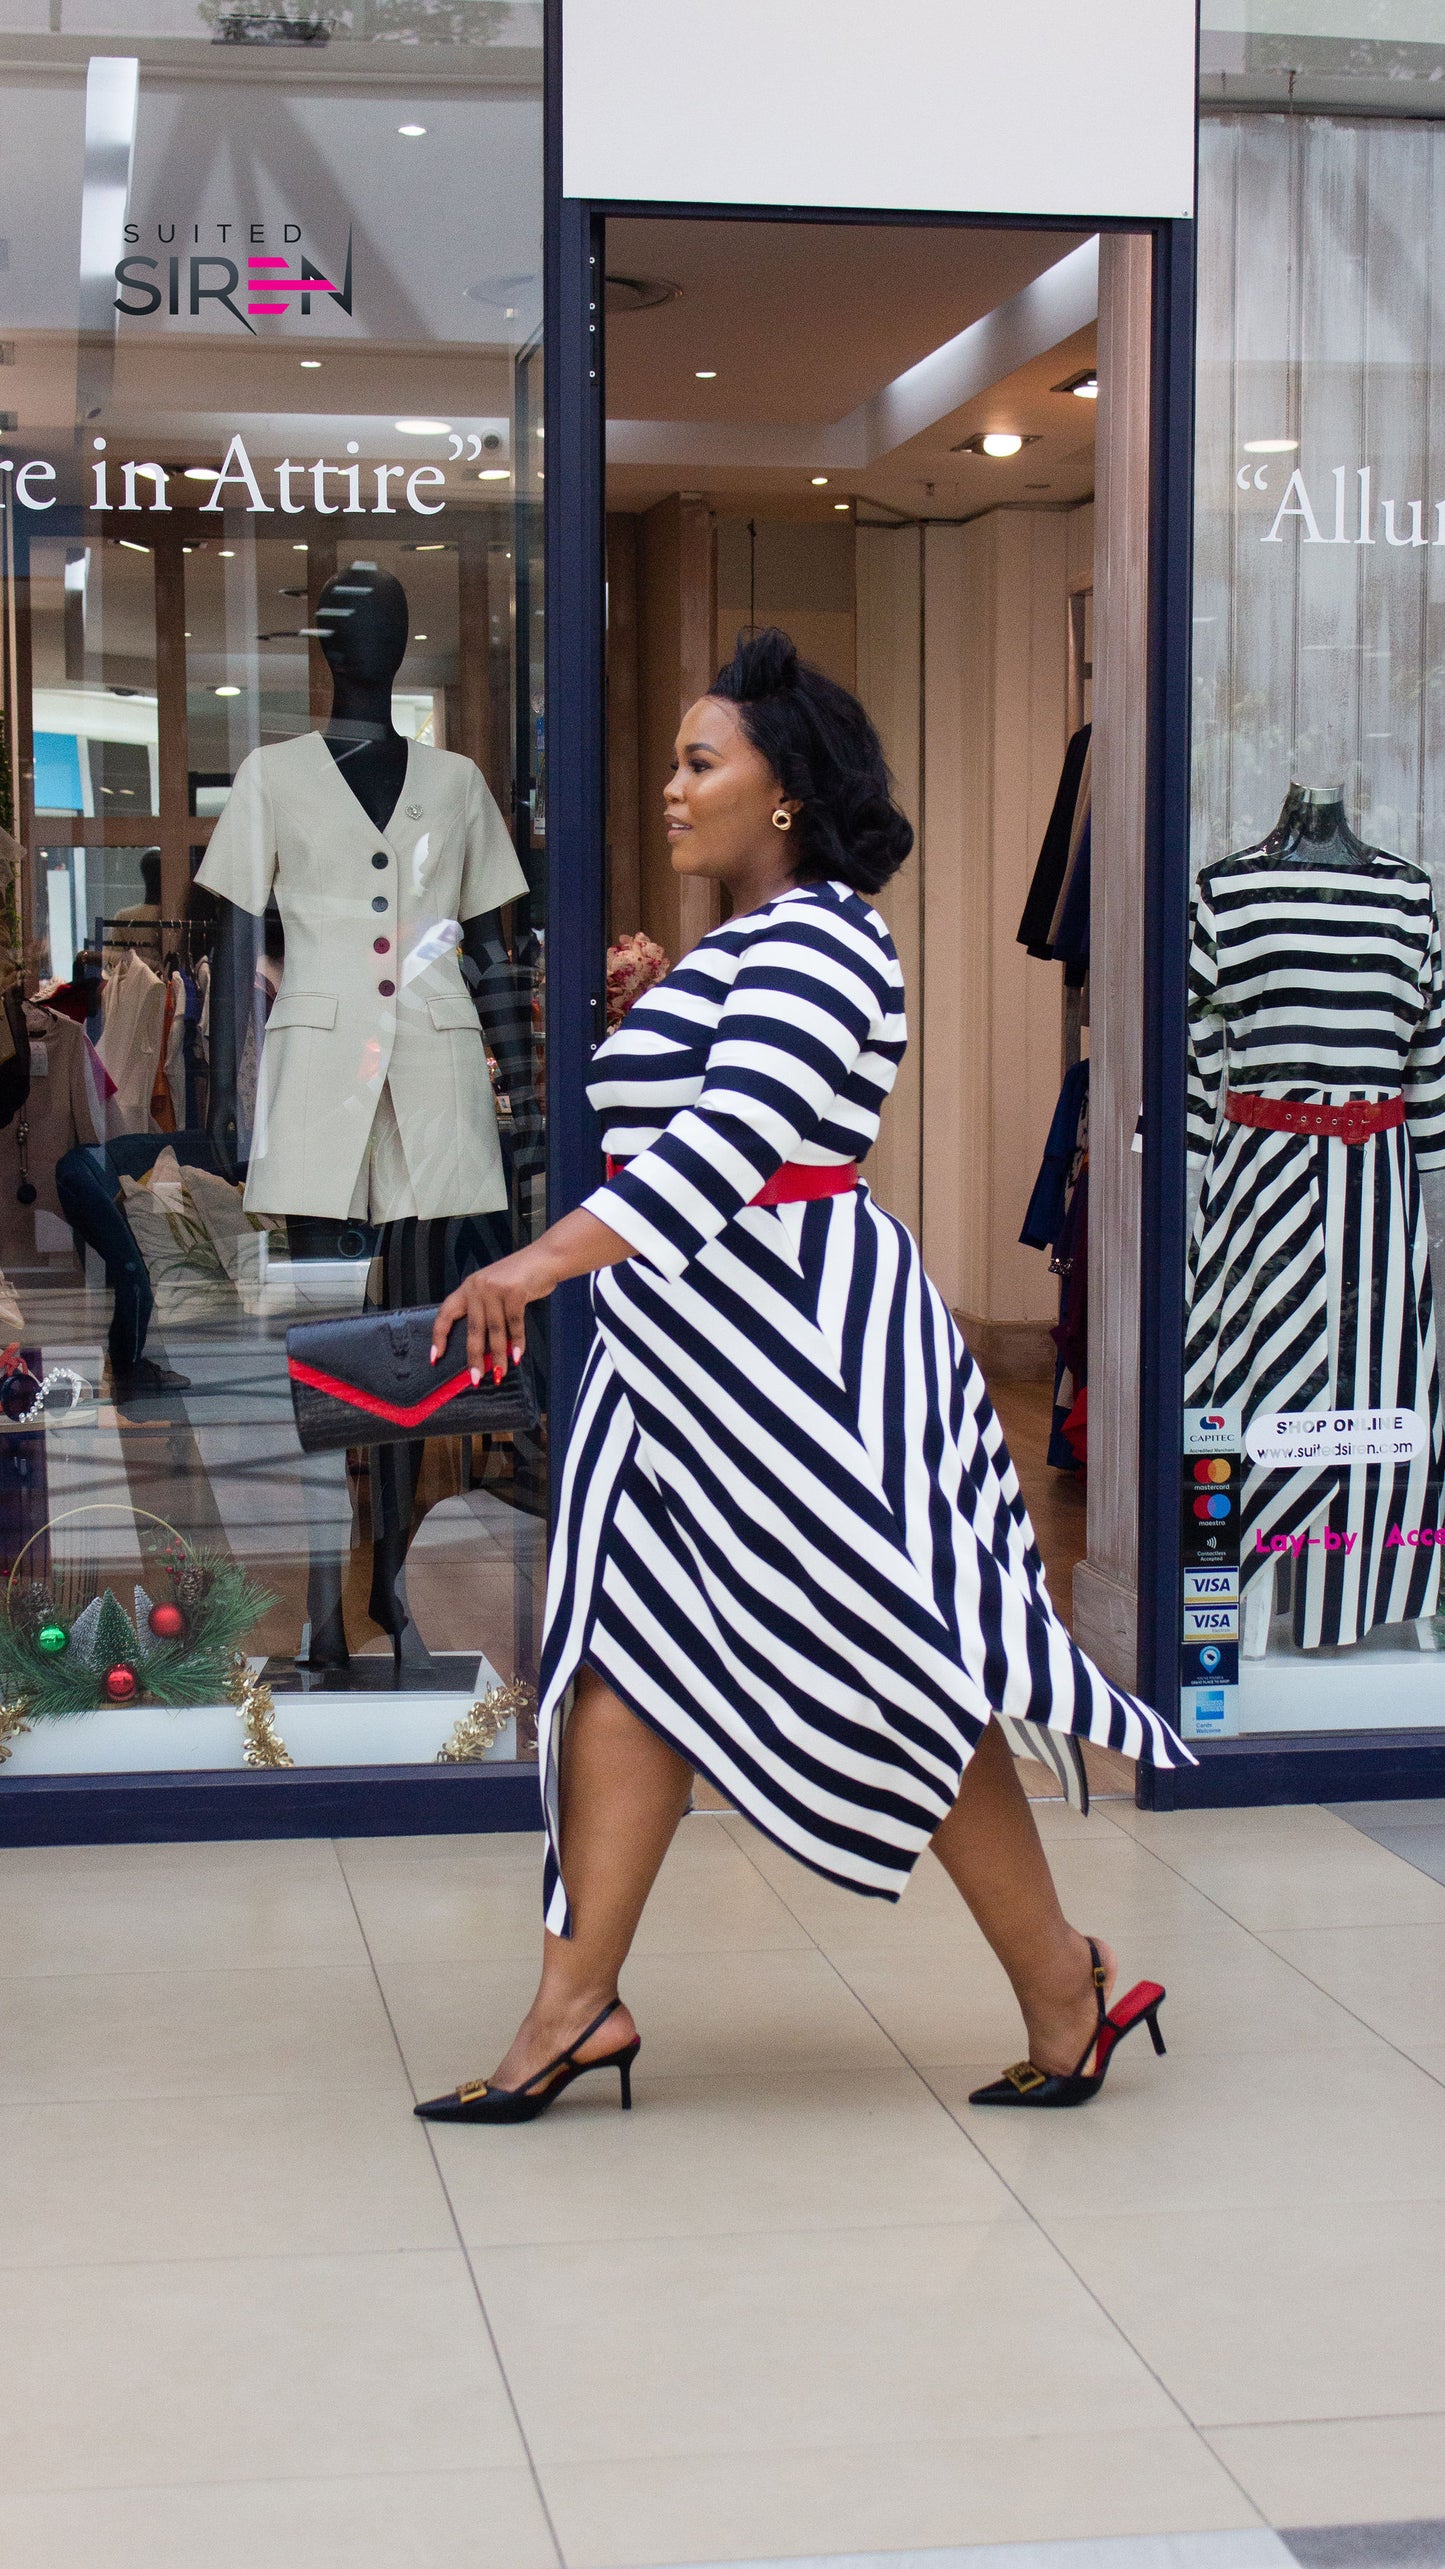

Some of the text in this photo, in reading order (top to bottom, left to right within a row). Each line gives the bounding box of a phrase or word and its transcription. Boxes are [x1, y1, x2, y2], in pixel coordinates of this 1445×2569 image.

[123, 223, 302, 244] SUITED
[112, 222, 353, 337] SIREN
[89, 437, 173, 512] in
[1276, 1416, 1404, 1435] SHOP ONLINE
[1189, 1433, 1235, 1443] CAPITEC
[1257, 1442, 1413, 1459] www.suitedsiren.com
[1255, 1525, 1358, 1559] Lay-by
[1191, 1577, 1231, 1593] VISA
[1191, 1613, 1231, 1628] VISA
